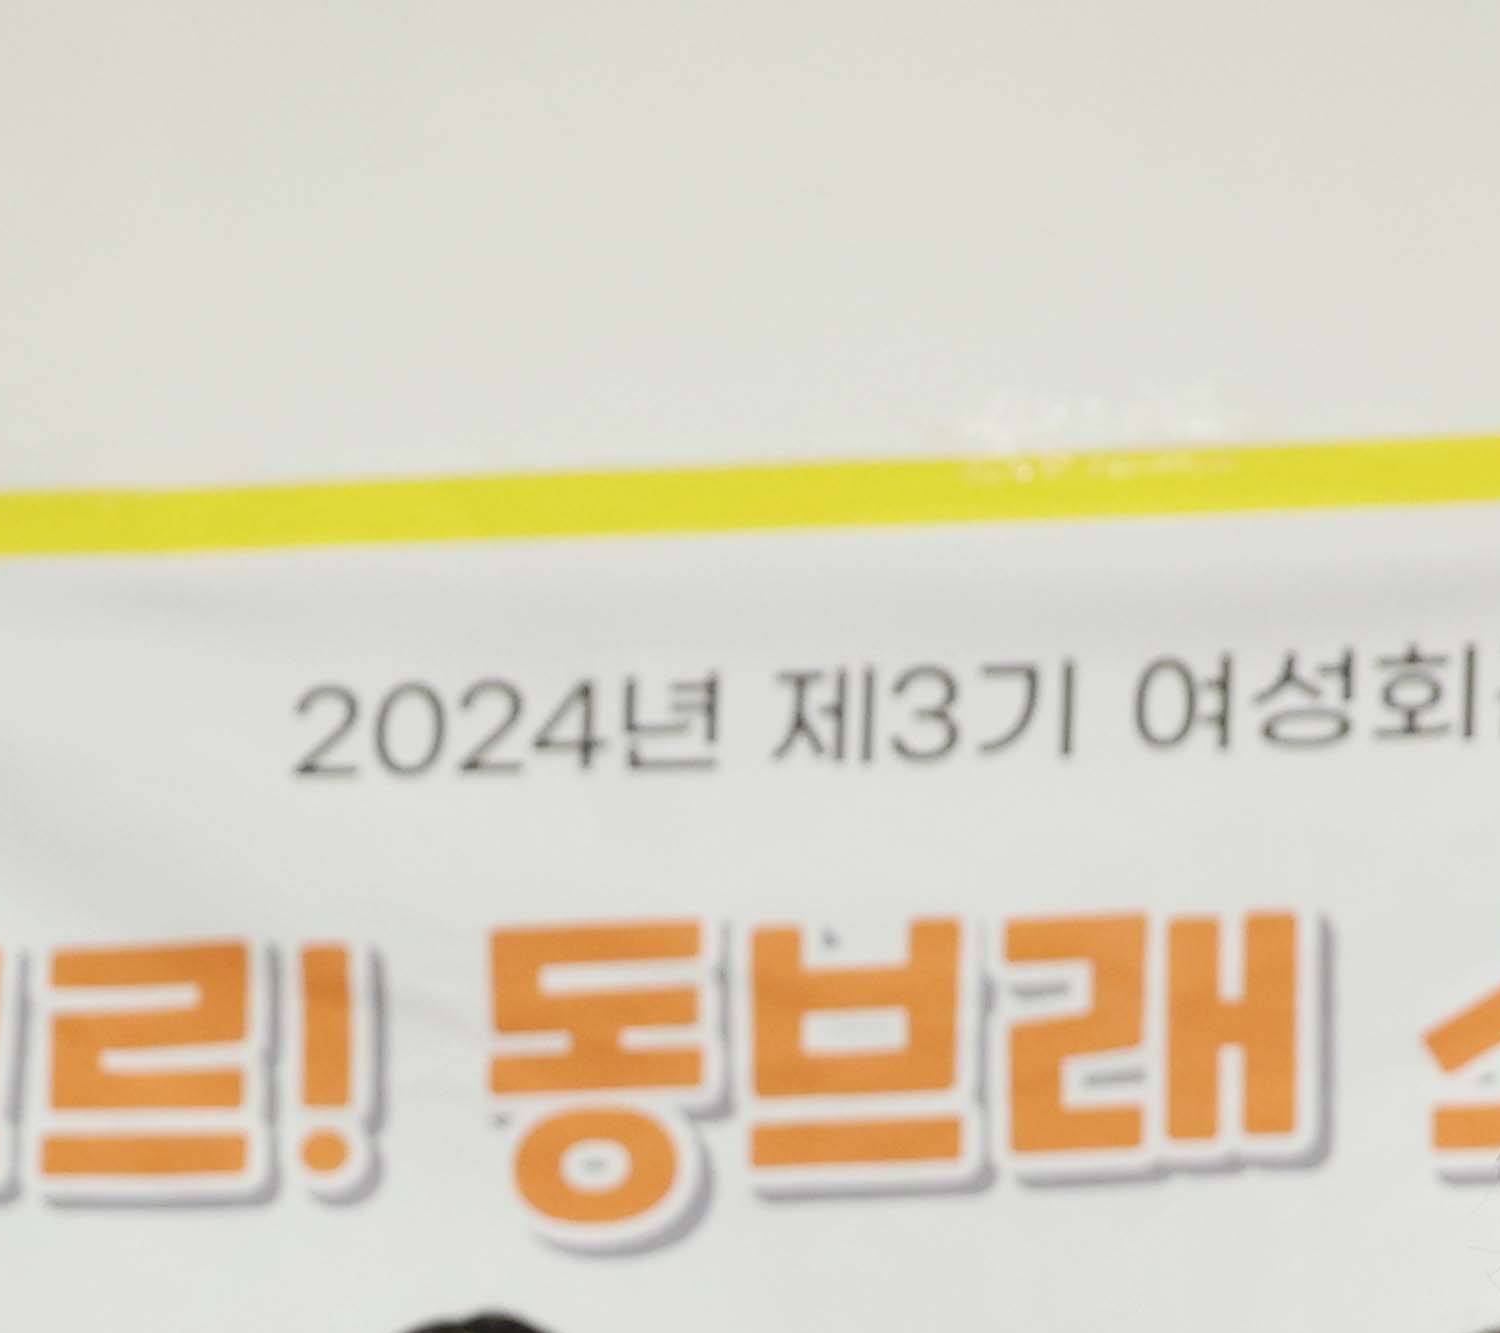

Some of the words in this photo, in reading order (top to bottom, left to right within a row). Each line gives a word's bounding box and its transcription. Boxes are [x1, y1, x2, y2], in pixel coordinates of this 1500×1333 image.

[292, 670, 722, 779] 2024년
[772, 658, 1077, 765] 제3기
[487, 910, 1299, 1227] 동브래
